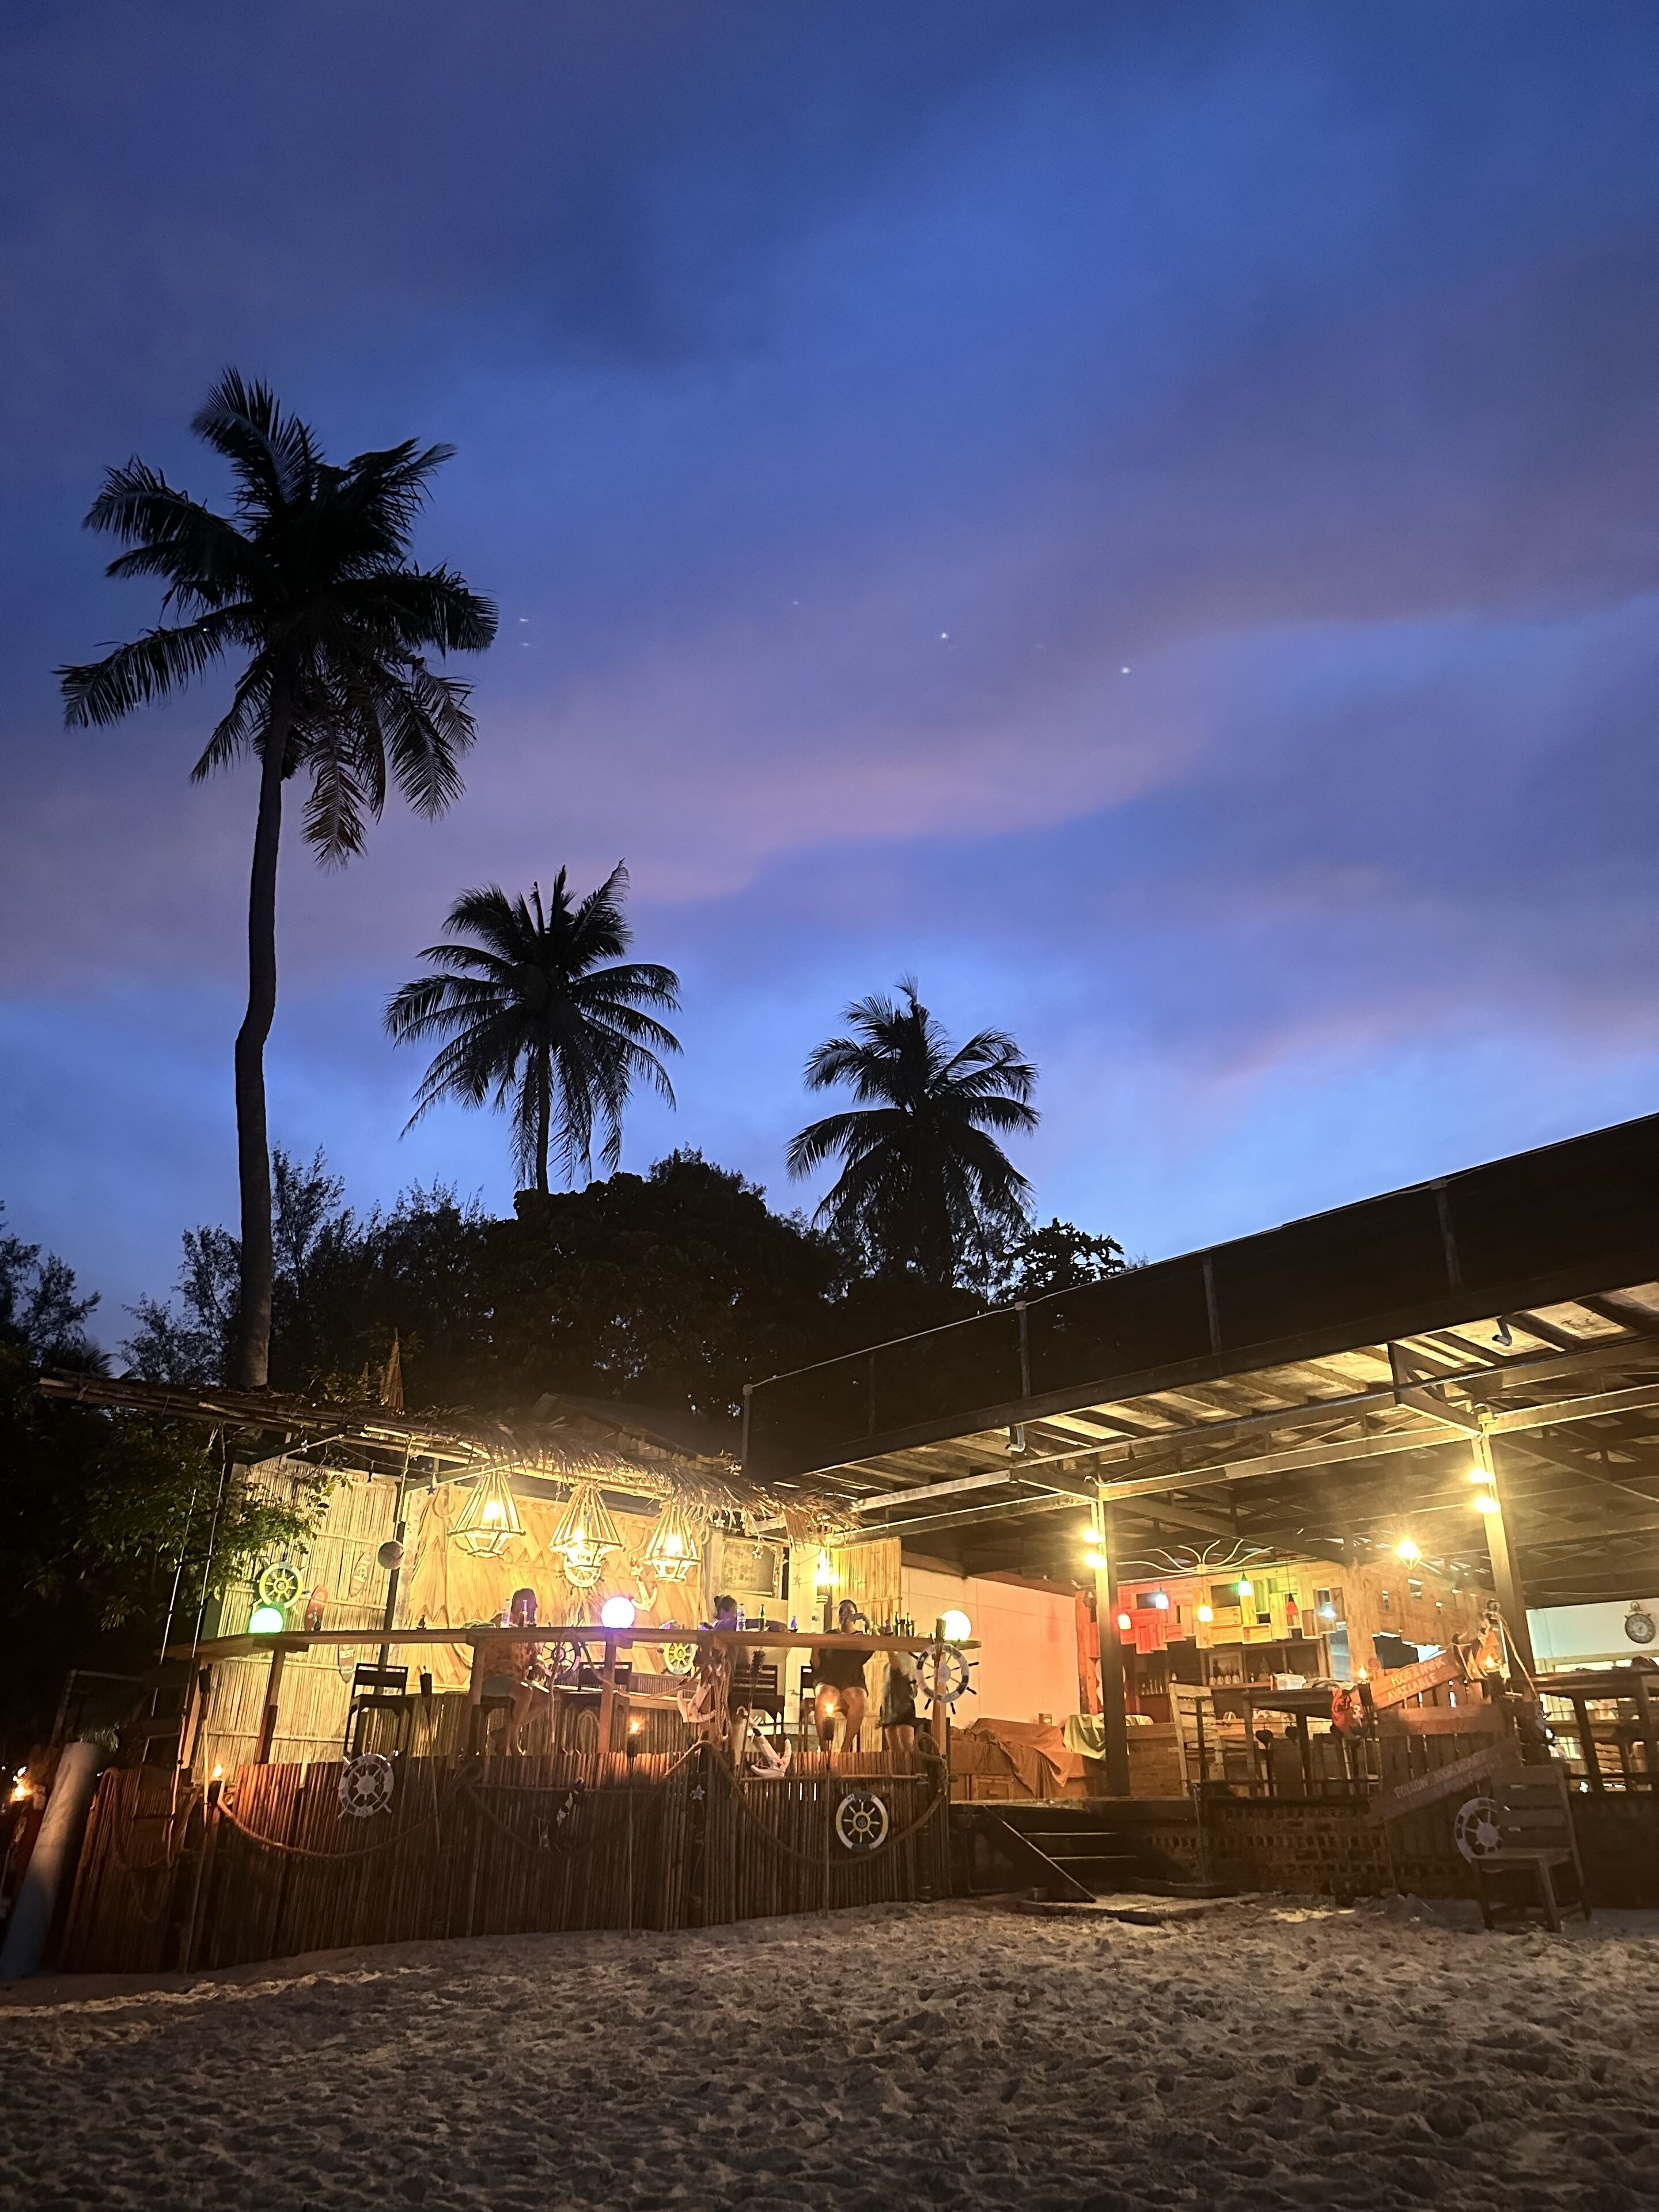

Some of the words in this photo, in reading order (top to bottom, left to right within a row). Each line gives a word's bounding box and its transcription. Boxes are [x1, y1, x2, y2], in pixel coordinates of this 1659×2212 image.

[1391, 1670, 1411, 1687] FOOD
[1419, 1656, 1447, 1675] DRINK
[1387, 1672, 1438, 1702] AVAILABLE
[1393, 1778, 1429, 1799] FOLLOW
